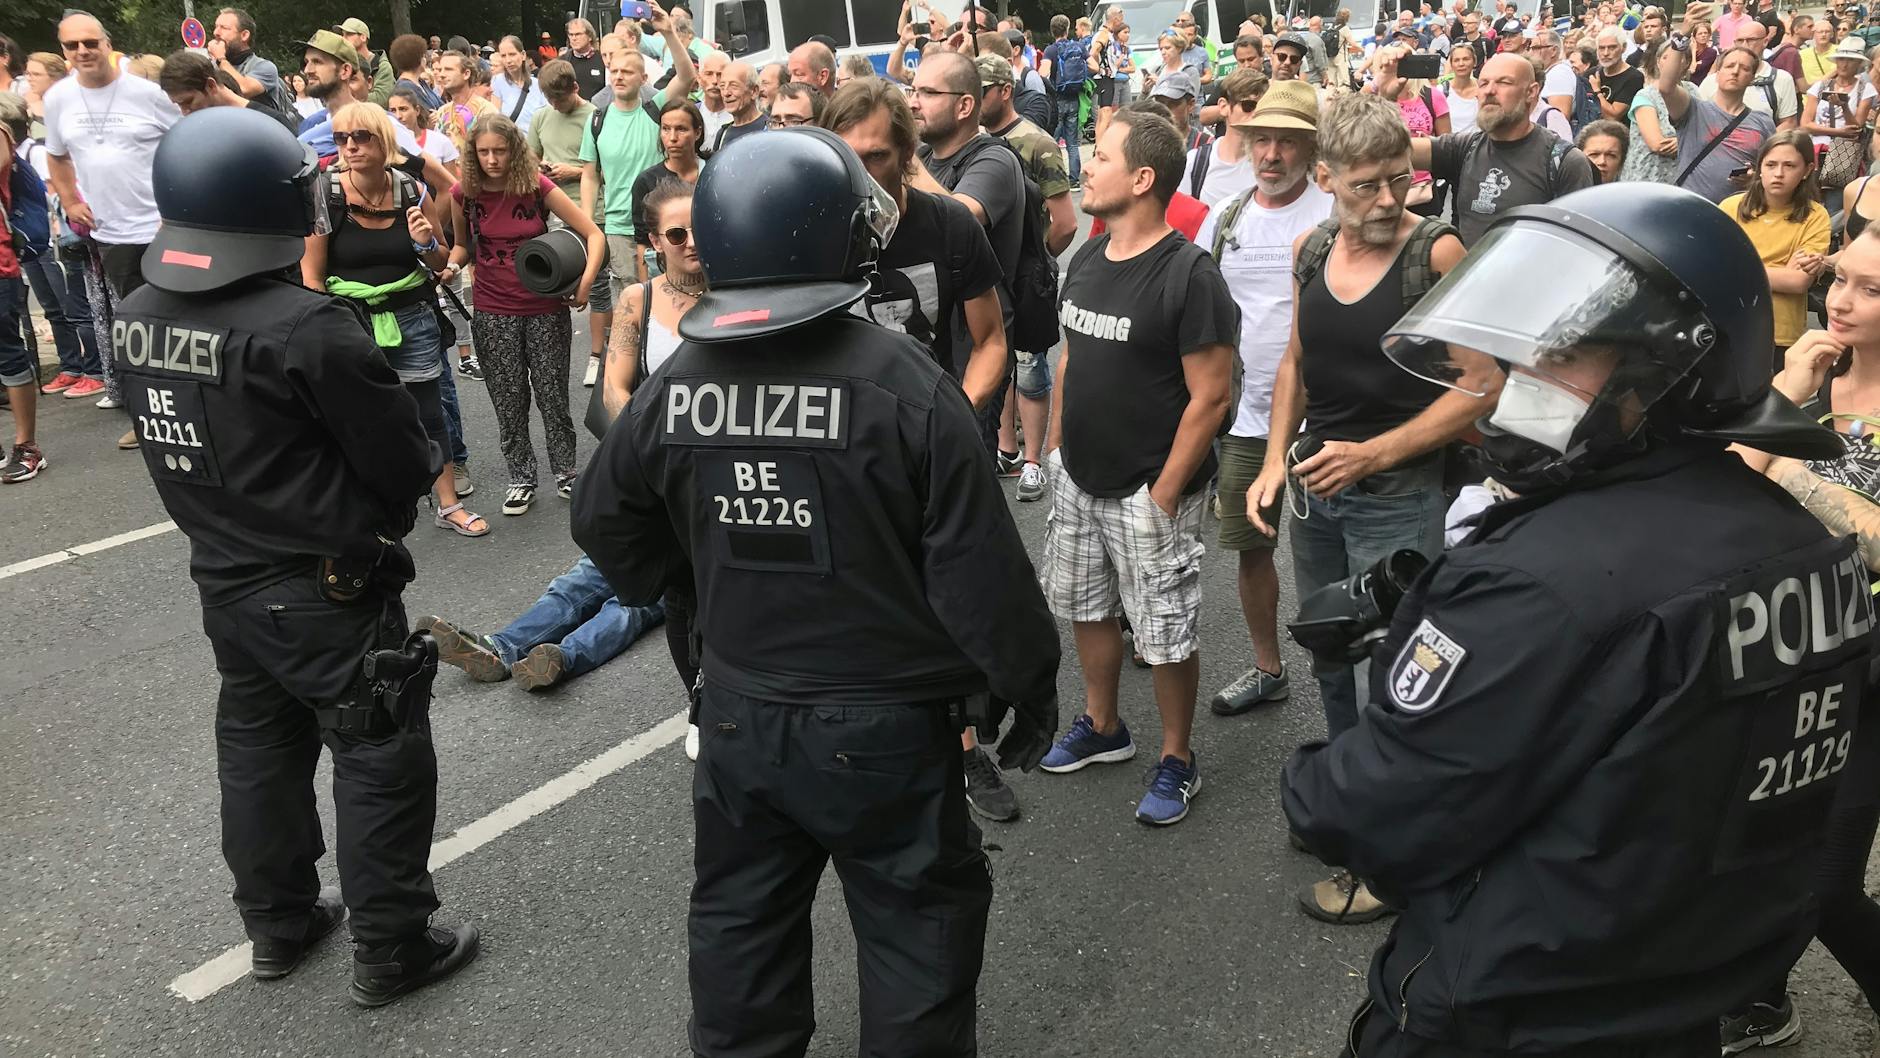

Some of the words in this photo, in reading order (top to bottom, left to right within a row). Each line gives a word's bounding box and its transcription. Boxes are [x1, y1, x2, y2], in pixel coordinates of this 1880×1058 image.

[1061, 299, 1131, 342] ÜRZBURG
[112, 320, 220, 377] POLIZEI
[147, 388, 176, 416] BE
[666, 383, 841, 440] POLIZEI
[139, 416, 203, 448] 21211
[733, 462, 781, 492] BE
[714, 495, 812, 528] 21226
[1418, 624, 1460, 665] POLIZEI
[1794, 683, 1844, 739] BE
[1749, 730, 1851, 801] 21129
